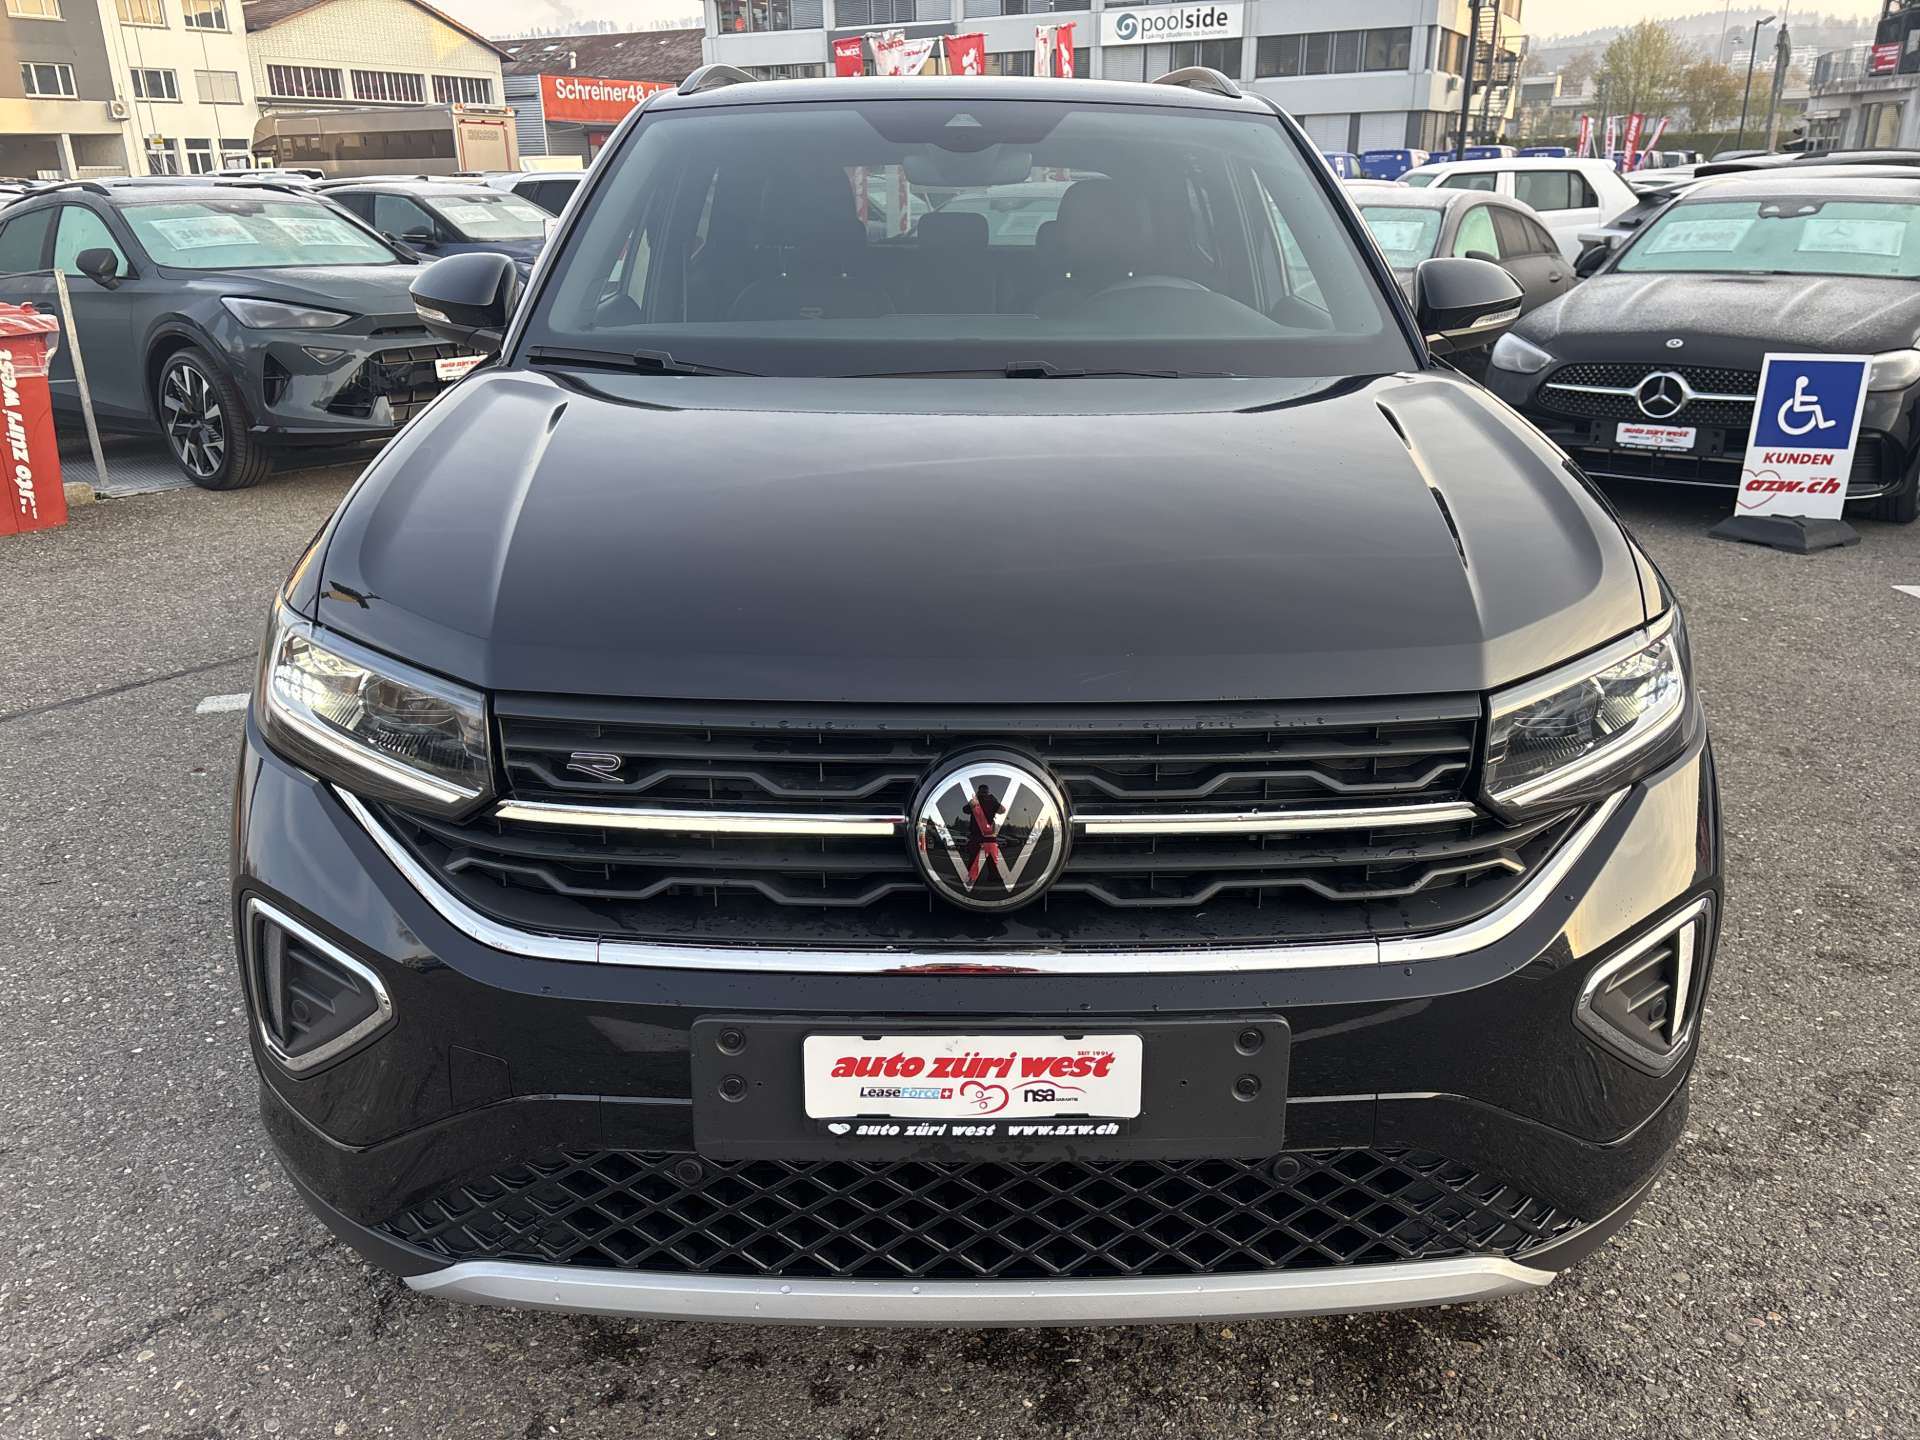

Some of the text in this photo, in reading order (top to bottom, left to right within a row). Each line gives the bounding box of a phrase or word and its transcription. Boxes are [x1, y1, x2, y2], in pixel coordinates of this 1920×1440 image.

[1141, 7, 1228, 40] poolside
[555, 78, 660, 103] Schreiner48c
[0, 349, 21, 406] west
[2, 409, 30, 463] züri
[1763, 452, 1834, 466] KUNDEN
[1745, 477, 1841, 495] azw.ch
[831, 1051, 1116, 1079] auto züri west
[859, 1087, 940, 1098] LeaseForce
[1024, 1088, 1055, 1102] nsa
[856, 1122, 1120, 1136] auto züri west www.azw.ch
